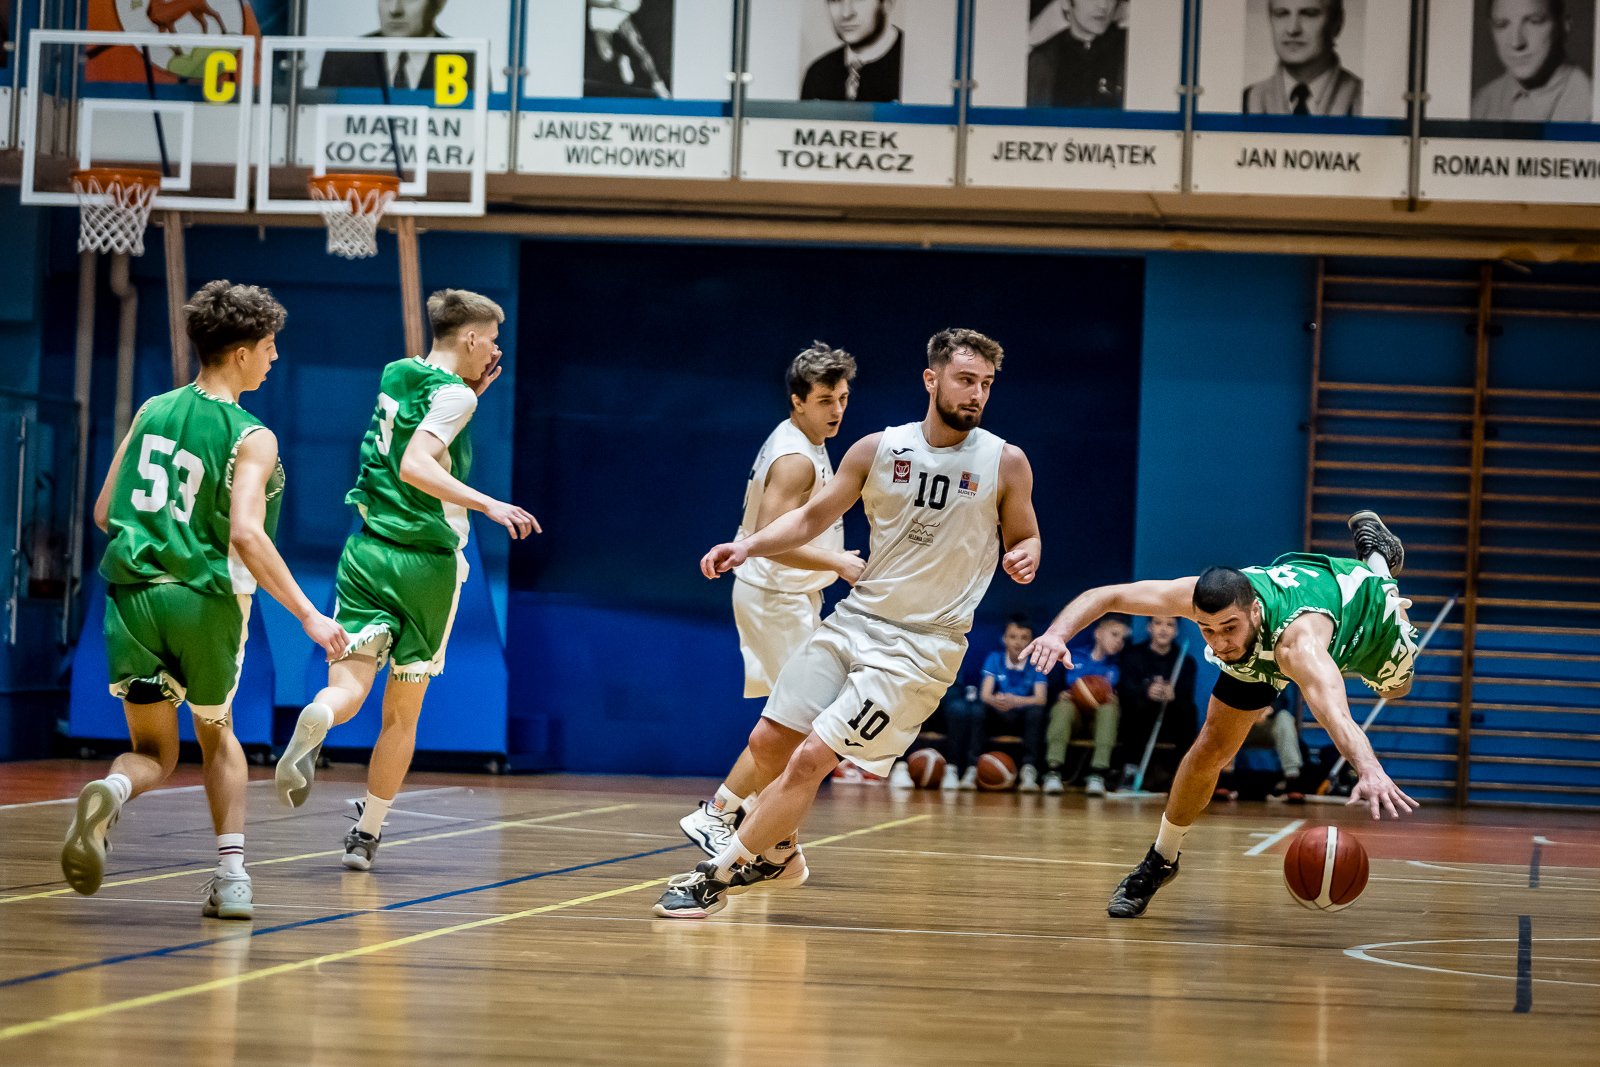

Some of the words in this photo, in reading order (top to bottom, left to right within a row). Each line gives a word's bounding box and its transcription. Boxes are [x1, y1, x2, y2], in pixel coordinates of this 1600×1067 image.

[203, 51, 237, 102] C
[434, 54, 468, 105] B
[346, 115, 461, 137] MARIAN
[533, 120, 612, 140] JANUSZ
[794, 128, 899, 150] MAREK
[566, 145, 686, 168] WICHOWSKI
[778, 149, 914, 173] TOŁKACZ
[993, 141, 1058, 162] JERZY
[1063, 138, 1157, 168] ŚWIĄTEK
[1236, 147, 1277, 169] JAN
[1283, 149, 1362, 172] NOWAK
[1432, 154, 1510, 176] ROMAN
[131, 434, 205, 524] 53
[914, 472, 950, 510] 10
[848, 699, 890, 741] 10
